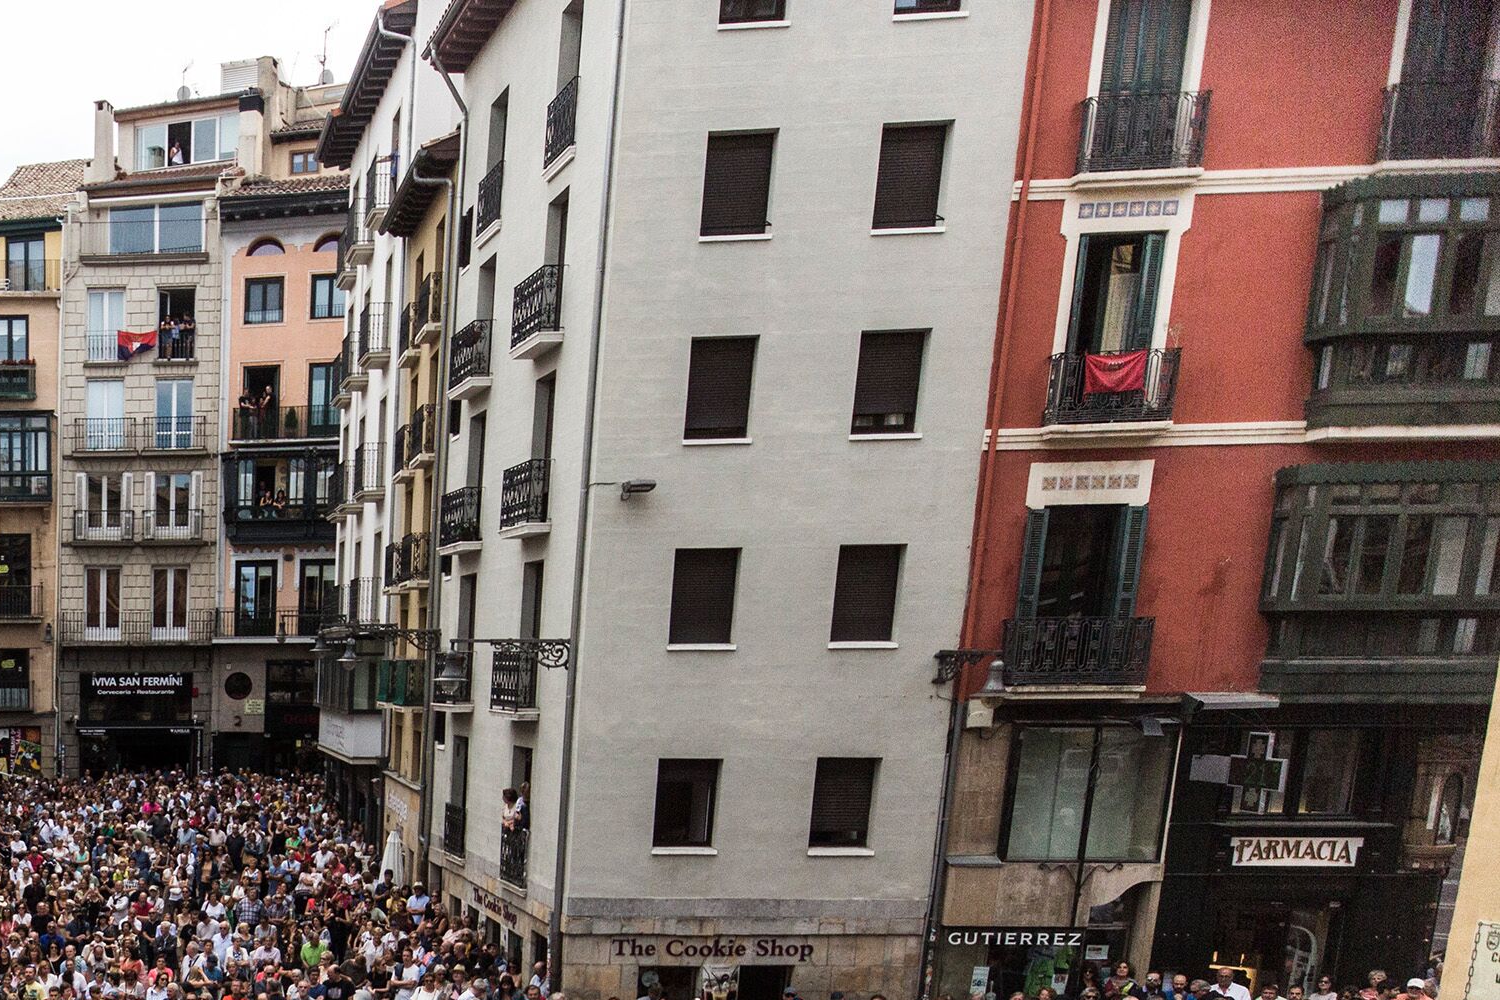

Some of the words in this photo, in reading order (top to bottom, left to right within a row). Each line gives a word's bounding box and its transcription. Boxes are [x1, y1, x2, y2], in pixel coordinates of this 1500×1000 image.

[119, 677, 140, 687] SAN
[143, 674, 183, 687] FERMÍN!
[1235, 839, 1352, 864] FARMACIA
[473, 887, 483, 905] The
[484, 893, 502, 916] Cookie
[503, 904, 518, 929] Shop
[612, 939, 656, 957] The
[666, 939, 746, 957] Cookie
[756, 939, 814, 962] Shop
[948, 932, 1082, 946] GUTIERREZ
